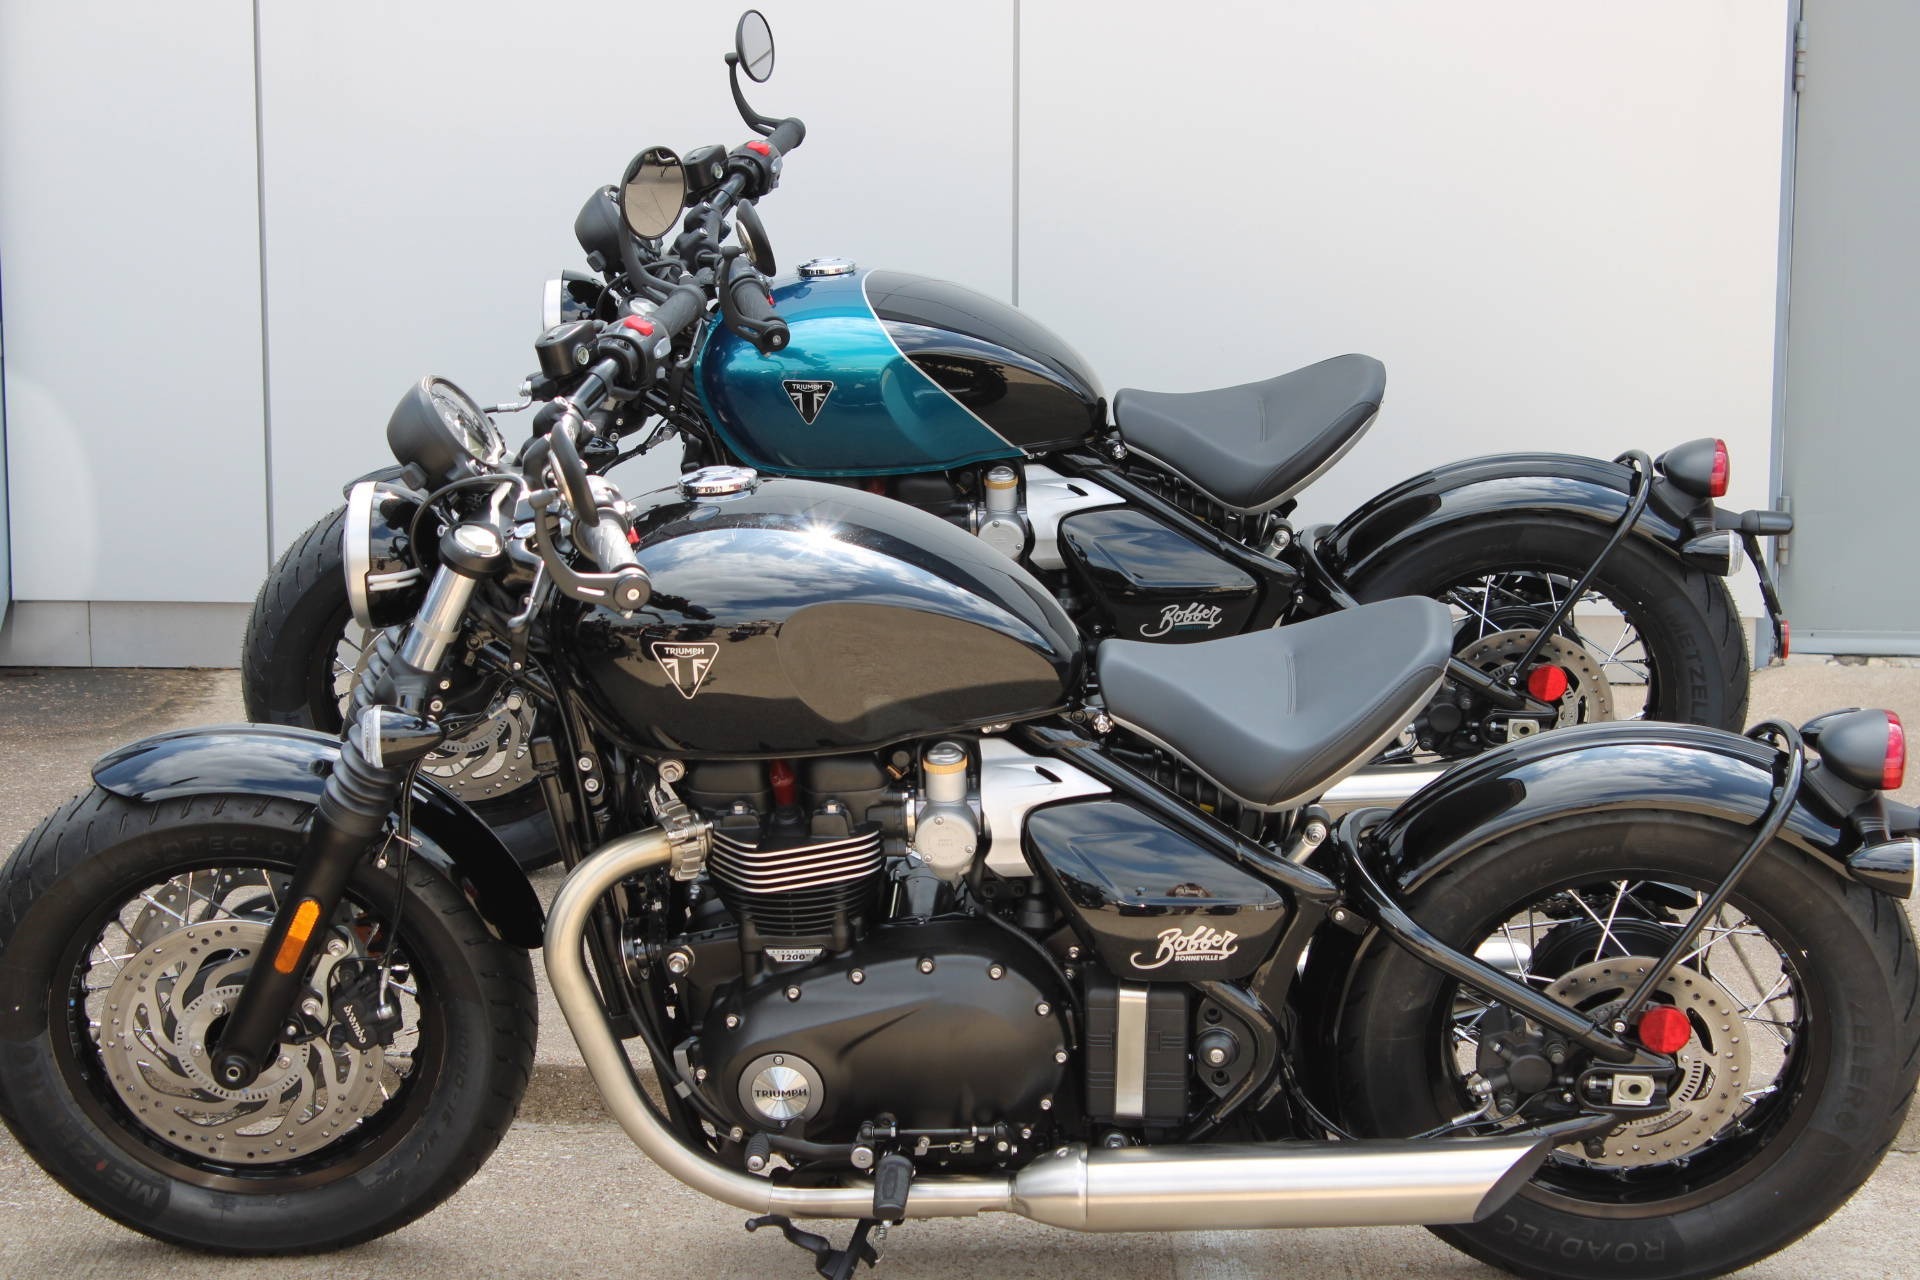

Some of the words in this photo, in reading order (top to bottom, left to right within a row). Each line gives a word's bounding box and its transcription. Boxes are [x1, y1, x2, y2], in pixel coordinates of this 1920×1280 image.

[791, 383, 823, 392] TRIUMPH
[1139, 602, 1222, 637] Bobber
[664, 646, 705, 658] TRIUMPH
[1130, 925, 1238, 969] Bobber
[781, 953, 806, 961] 1200
[1174, 954, 1220, 962] BONNEVILLE
[343, 1004, 367, 1044] brembo
[754, 1088, 808, 1101] TRIUMPH
[1496, 1213, 1666, 1264] ROADTEC
